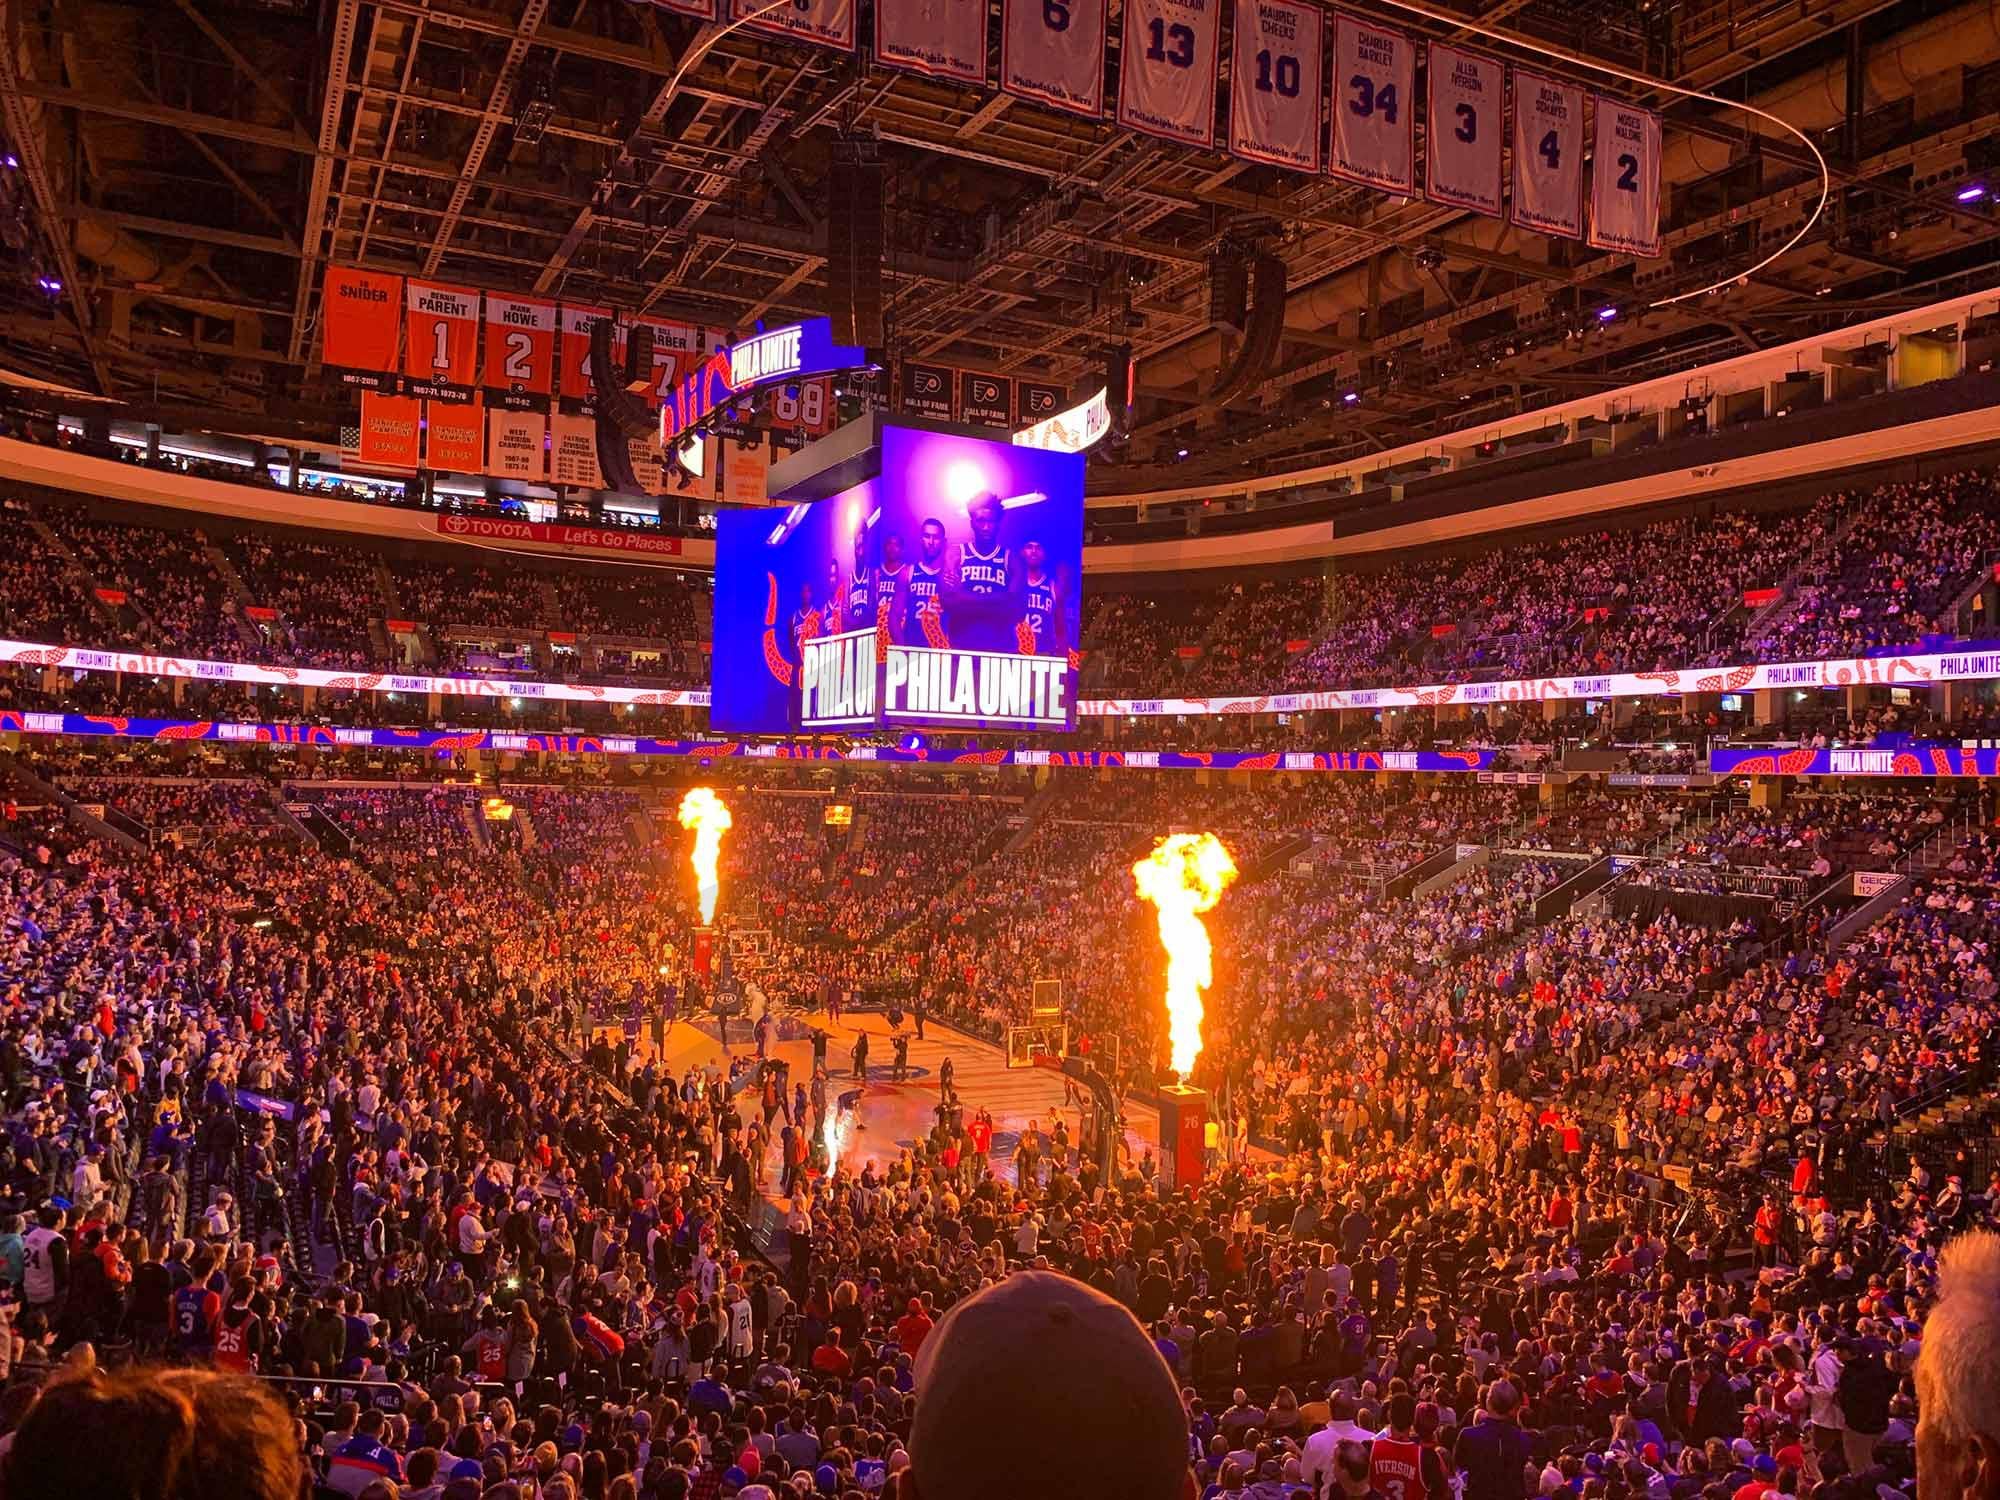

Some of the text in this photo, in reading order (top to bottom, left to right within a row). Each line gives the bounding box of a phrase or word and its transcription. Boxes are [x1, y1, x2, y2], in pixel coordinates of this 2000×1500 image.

[1043, 0, 1071, 32] 6
[1259, 4, 1298, 27] MAURICE
[1261, 19, 1295, 40] CHEEKS
[1146, 17, 1195, 68] 13
[1358, 31, 1394, 51] CHARLES
[1358, 46, 1393, 67] BARKLEY
[1256, 49, 1300, 98] 10
[1456, 61, 1479, 78] ALLEN
[1451, 72, 1482, 93] IVERSON
[1350, 75, 1398, 124] 34
[1455, 102, 1477, 144] 3
[1617, 113, 1640, 130] MOSES
[1538, 130, 1561, 169] 4
[1617, 153, 1638, 193] 2
[339, 285, 388, 302] SNIDER
[418, 297, 468, 316] PARENT
[503, 310, 538, 327] HOWE
[432, 320, 449, 369] 1
[505, 331, 532, 380] 2
[731, 330, 802, 386] PHILA UNITE
[652, 353, 676, 398] 7
[931, 402, 949, 411] FAME
[503, 435, 532, 443] DIVISION
[509, 428, 527, 436] WEST
[563, 435, 590, 444] PATRICK
[498, 441, 536, 451] CHAMPIONS
[558, 448, 595, 458] CHAMPIONS
[563, 441, 590, 451] DIVISION
[472, 520, 533, 539] TOYOTA
[564, 528, 672, 552] Let's Go Places
[961, 565, 1006, 586] PHILA
[850, 590, 868, 606] PHILA
[76, 652, 112, 667] PHILA UNITE
[1940, 654, 2000, 675] PHILA UNITE
[197, 664, 234, 677] PHILA UNITE
[802, 638, 854, 718] PHILA
[1767, 666, 1816, 683] PHILA UNITE
[392, 677, 428, 690] PHILA UNITE
[509, 684, 545, 696] PHILA UNITE
[885, 650, 1068, 719] PHILA UNITE
[1464, 685, 1496, 699] PHILA UNITE
[1573, 678, 1611, 694] PHILA UNITE
[1131, 702, 1164, 713] PHILA UNITE
[24, 714, 43, 731] PHILA
[1015, 751, 1031, 764] PHILA
[1830, 752, 1894, 772] PHILA UNITE
[24, 1247, 41, 1269] 24
[180, 1312, 194, 1334] 3
[217, 1331, 241, 1352] 25
[483, 1349, 501, 1362] 25
[1375, 1460, 1416, 1480] IVERSON
